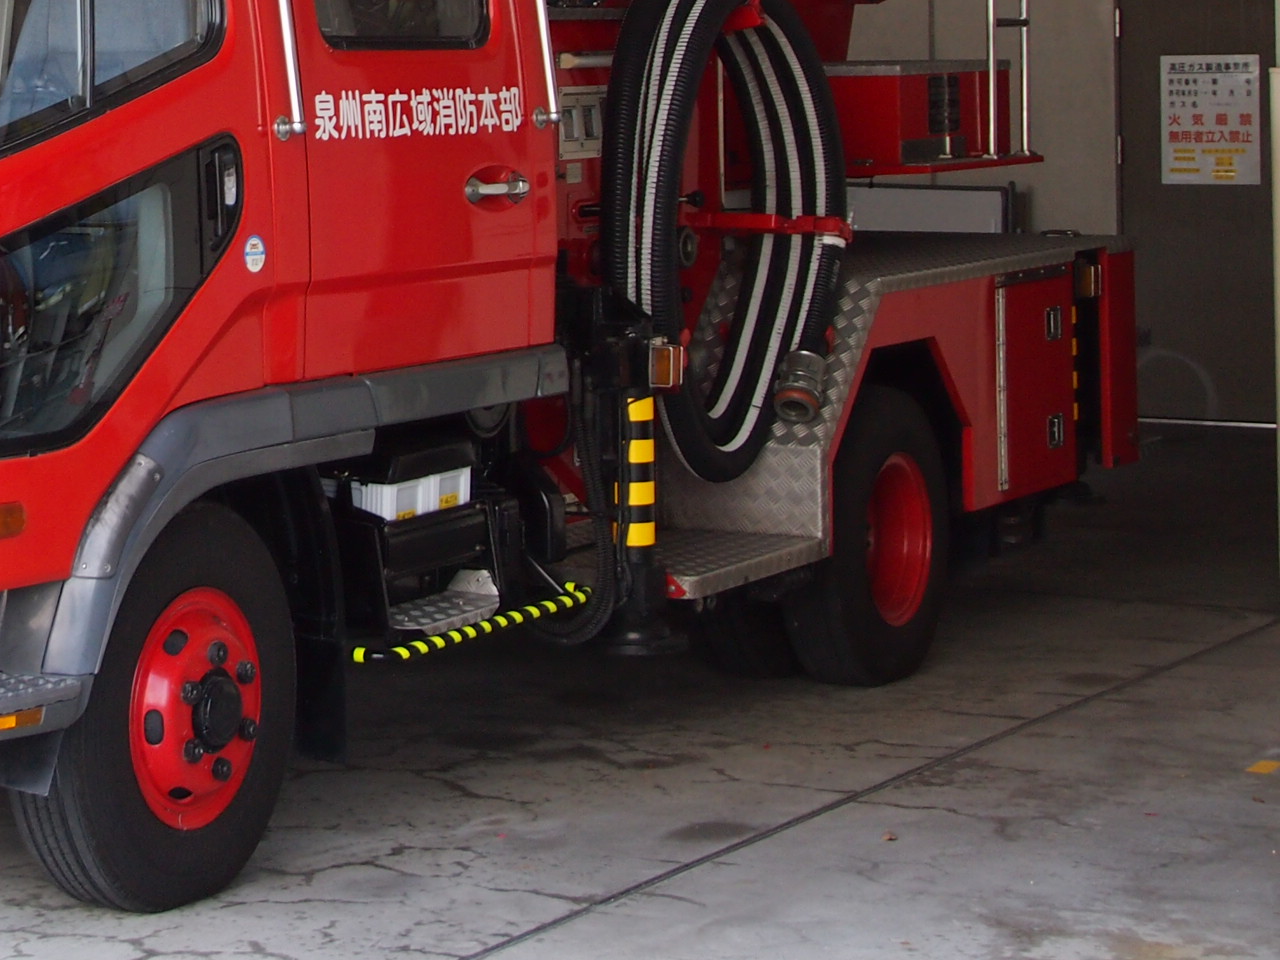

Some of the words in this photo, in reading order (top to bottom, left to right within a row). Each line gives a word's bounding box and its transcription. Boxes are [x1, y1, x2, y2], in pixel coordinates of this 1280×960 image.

[315, 87, 524, 141] 泉州南広域消防本部
